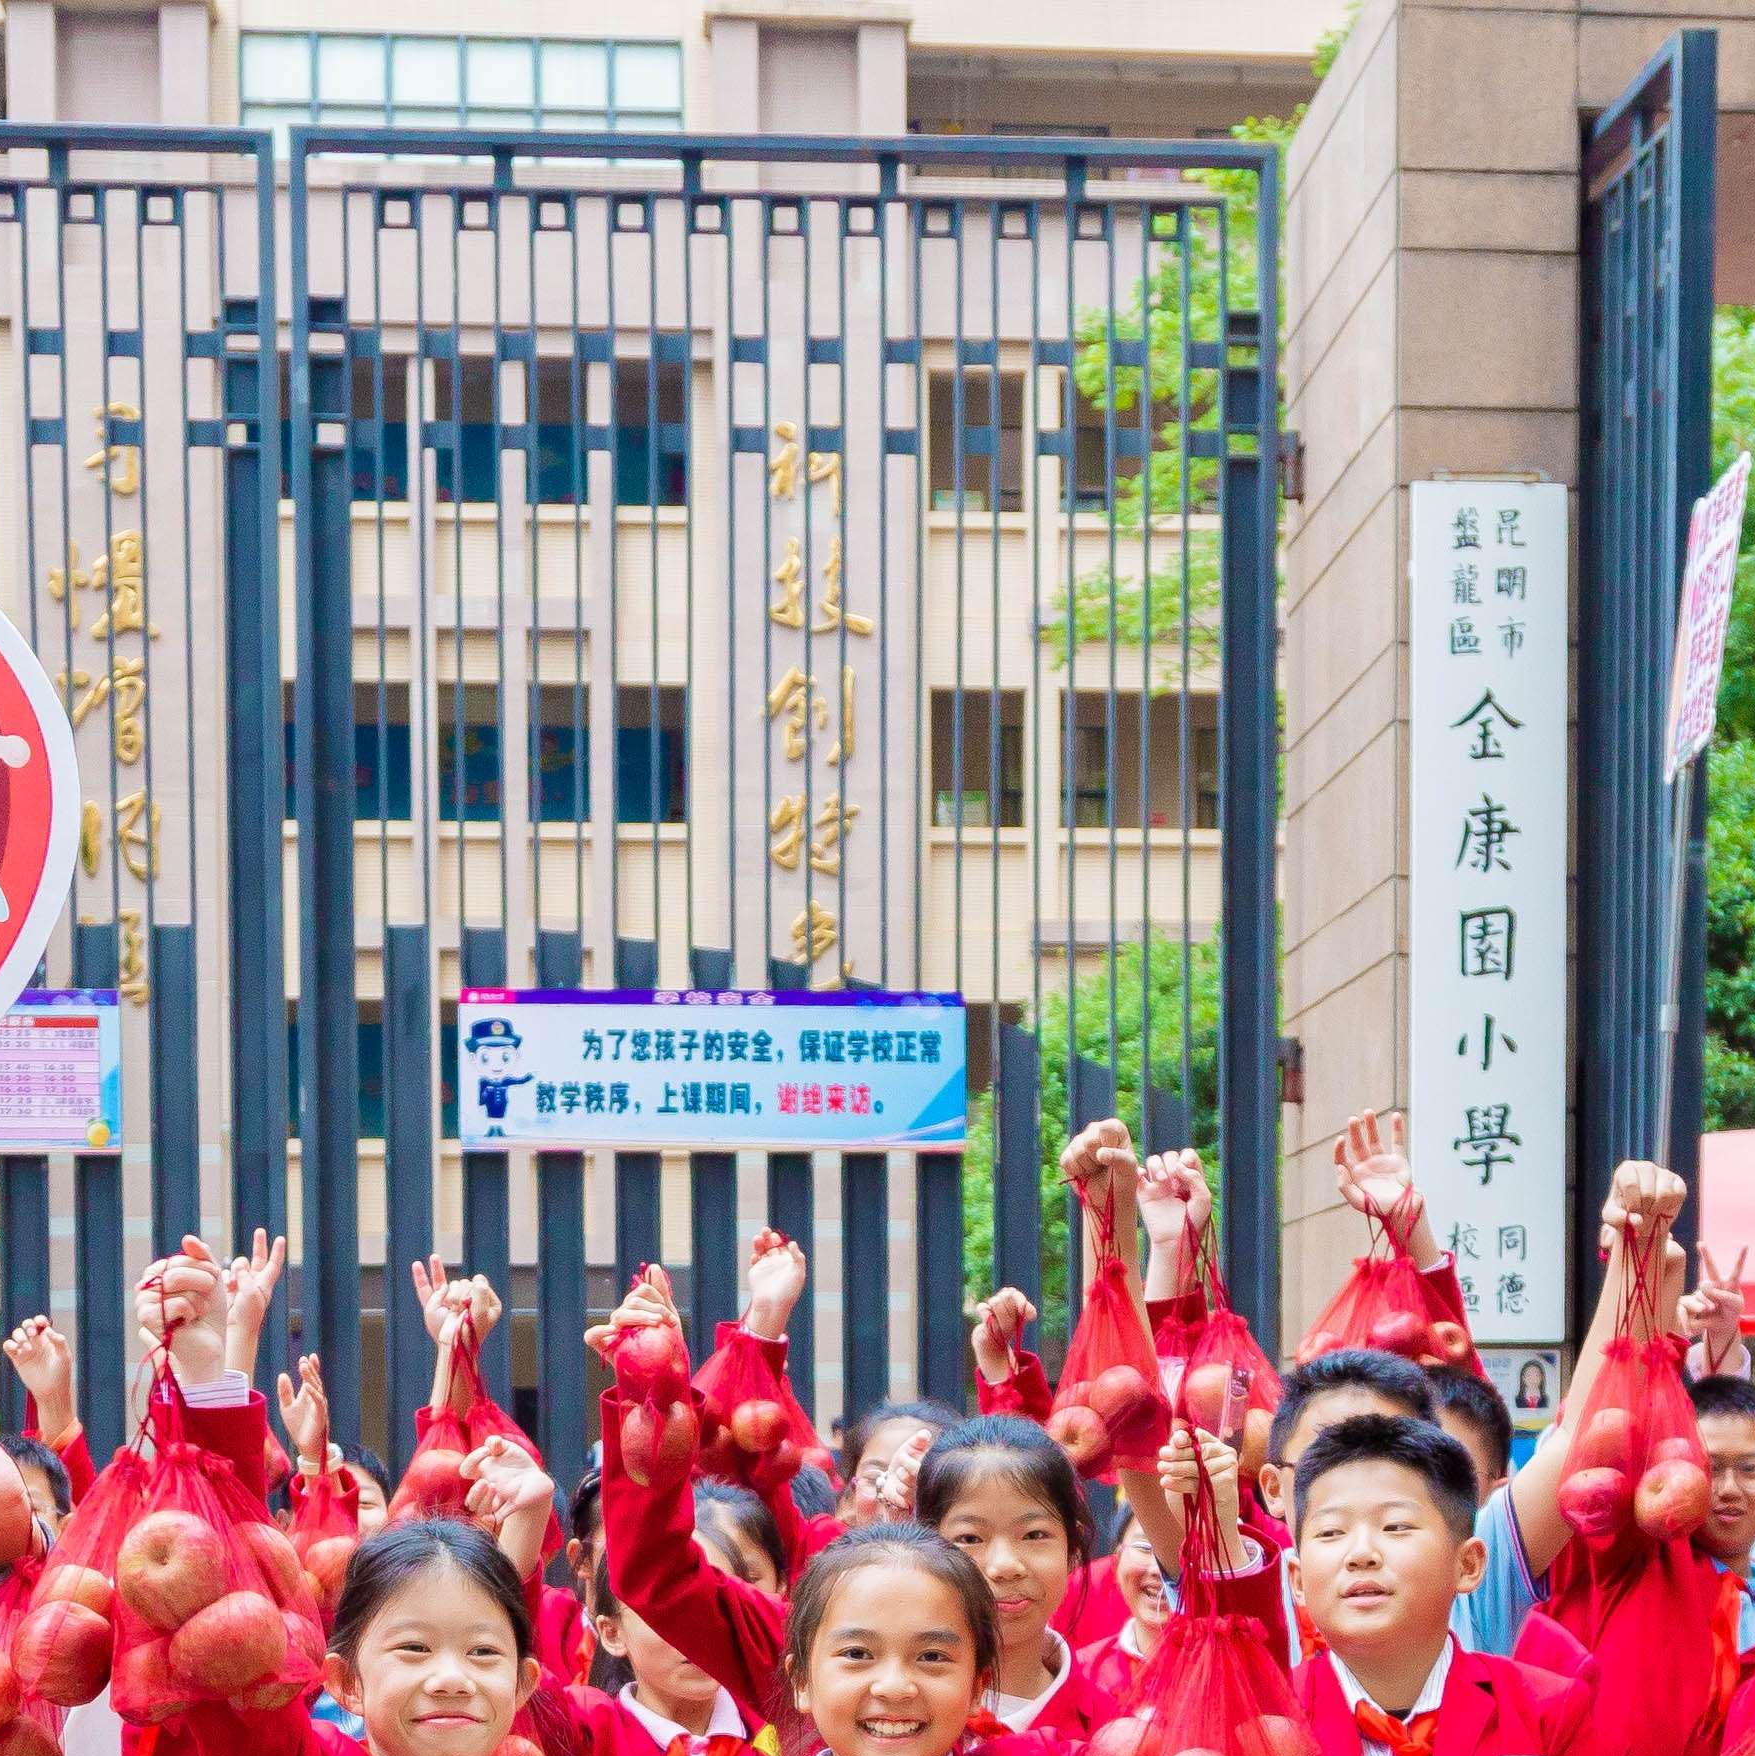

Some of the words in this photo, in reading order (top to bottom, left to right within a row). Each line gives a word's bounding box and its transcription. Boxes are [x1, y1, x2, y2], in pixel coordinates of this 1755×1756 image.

[1493, 508, 1529, 659] 昆明市
[582, 1028, 942, 1063] 为了您孩子的安全，保证学校正常
[535, 1080, 885, 1116] 教学秩序，上课期间，谢绝来访。
[1496, 1223, 1531, 1315] 同德
